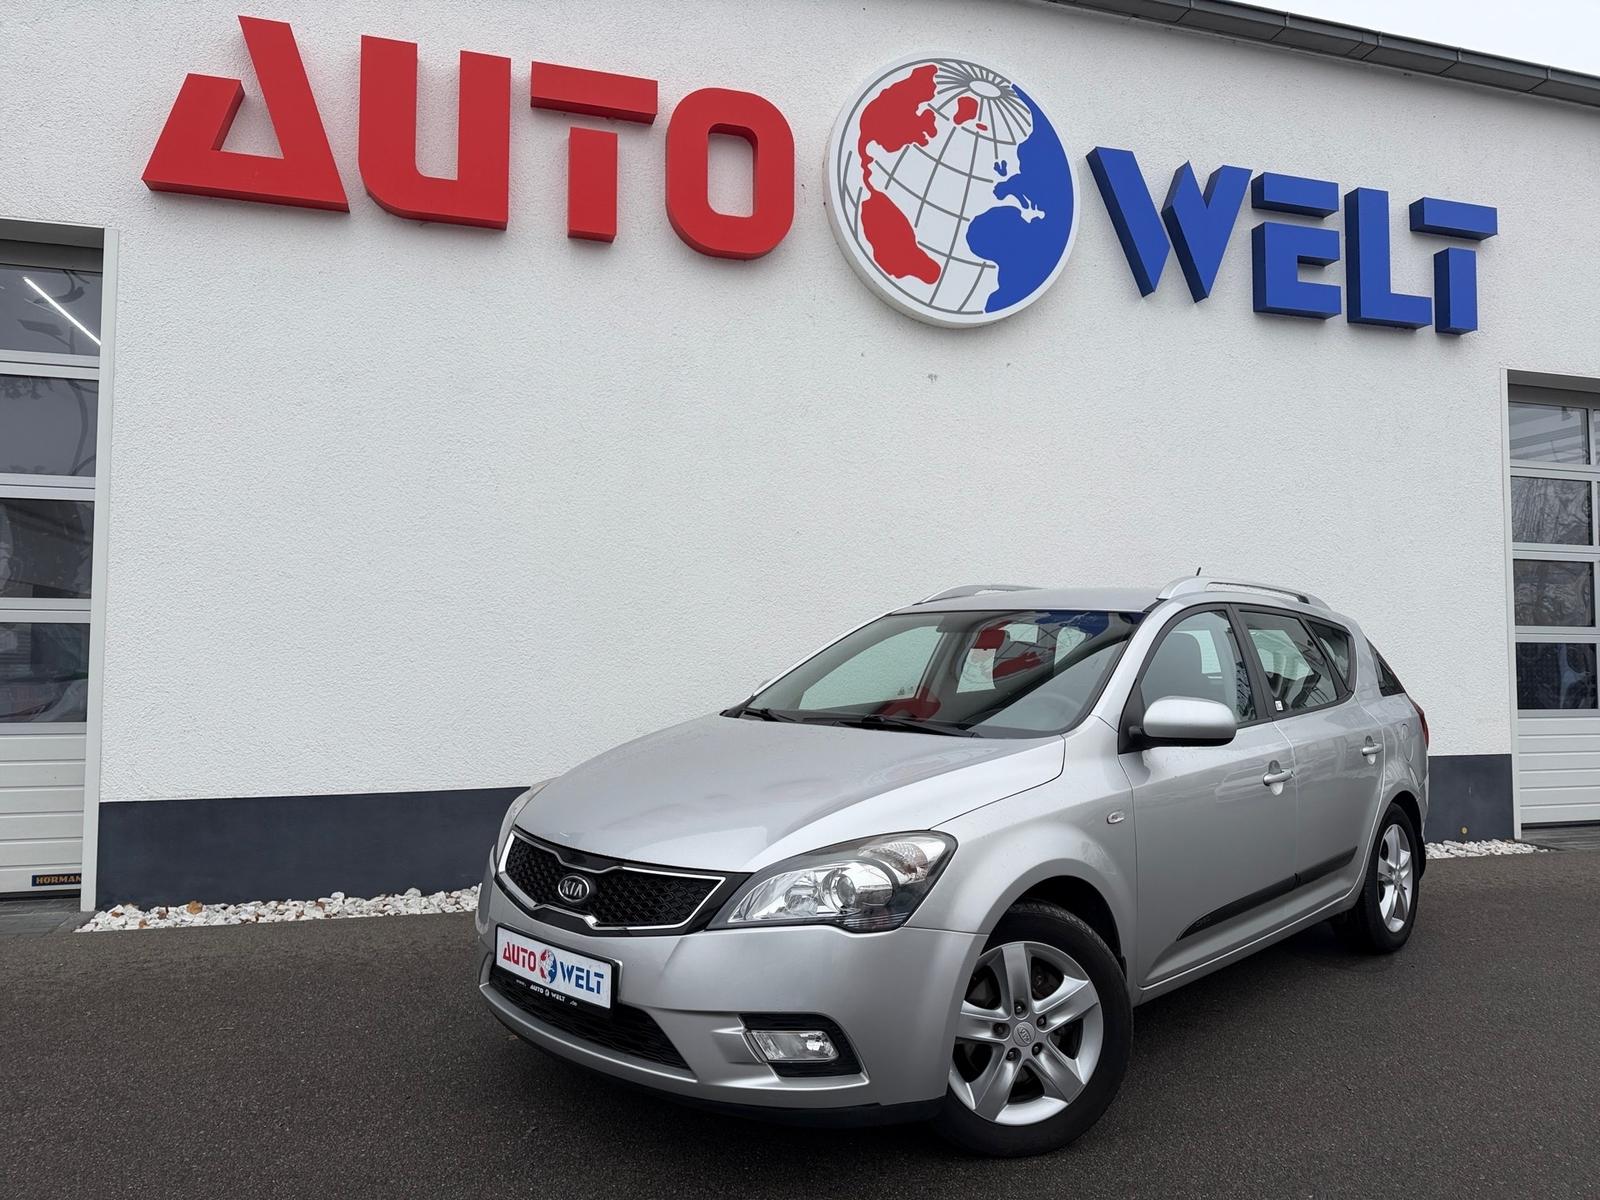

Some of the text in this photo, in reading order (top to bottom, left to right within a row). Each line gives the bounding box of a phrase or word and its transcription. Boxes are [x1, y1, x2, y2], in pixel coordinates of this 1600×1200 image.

[142, 16, 1498, 335] AUTO WELT
[562, 880, 583, 897] KIA
[503, 942, 604, 994] AUTO WELT
[529, 984, 566, 1002] AUTO WELT
